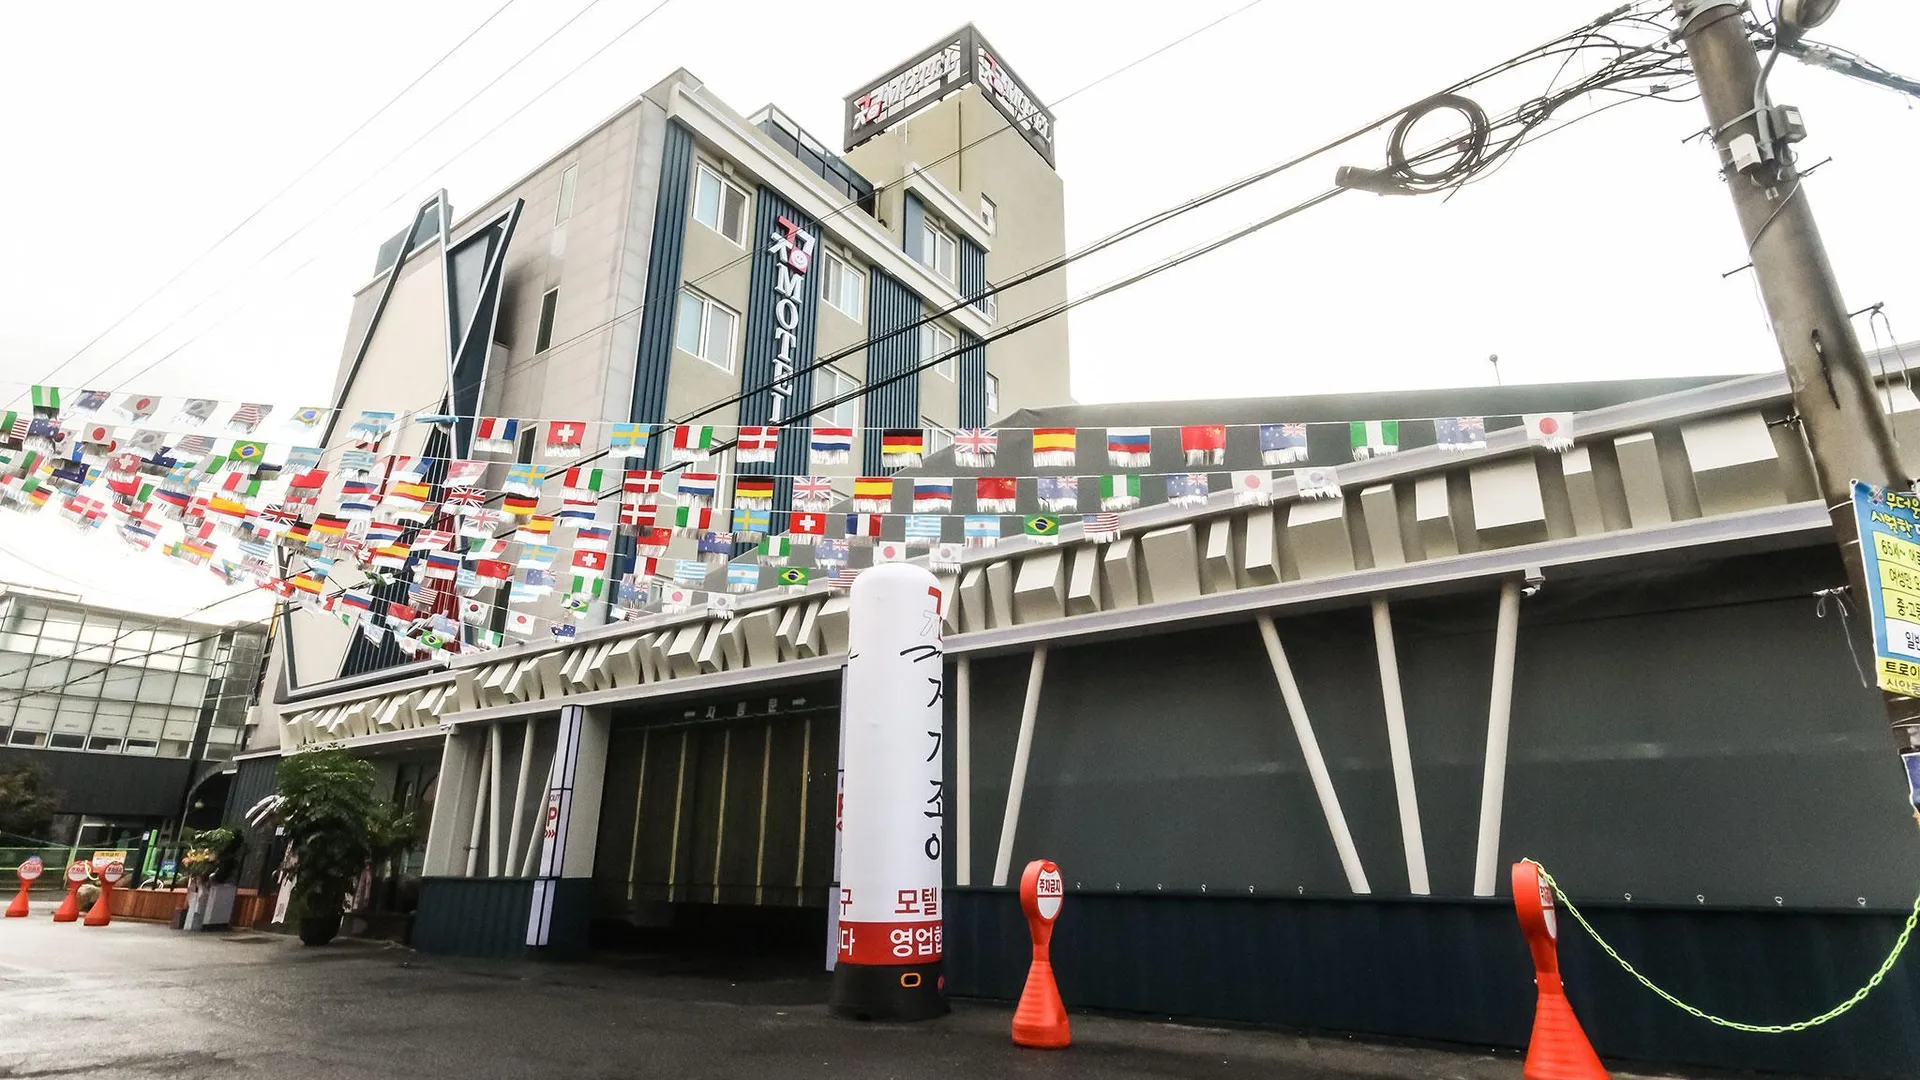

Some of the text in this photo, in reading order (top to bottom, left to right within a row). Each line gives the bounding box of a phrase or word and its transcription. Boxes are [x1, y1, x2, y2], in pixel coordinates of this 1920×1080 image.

[769, 262, 804, 425] MOTEL
[547, 807, 557, 827] P
[1039, 879, 1060, 893] 주차금지
[894, 887, 937, 916] 모텔
